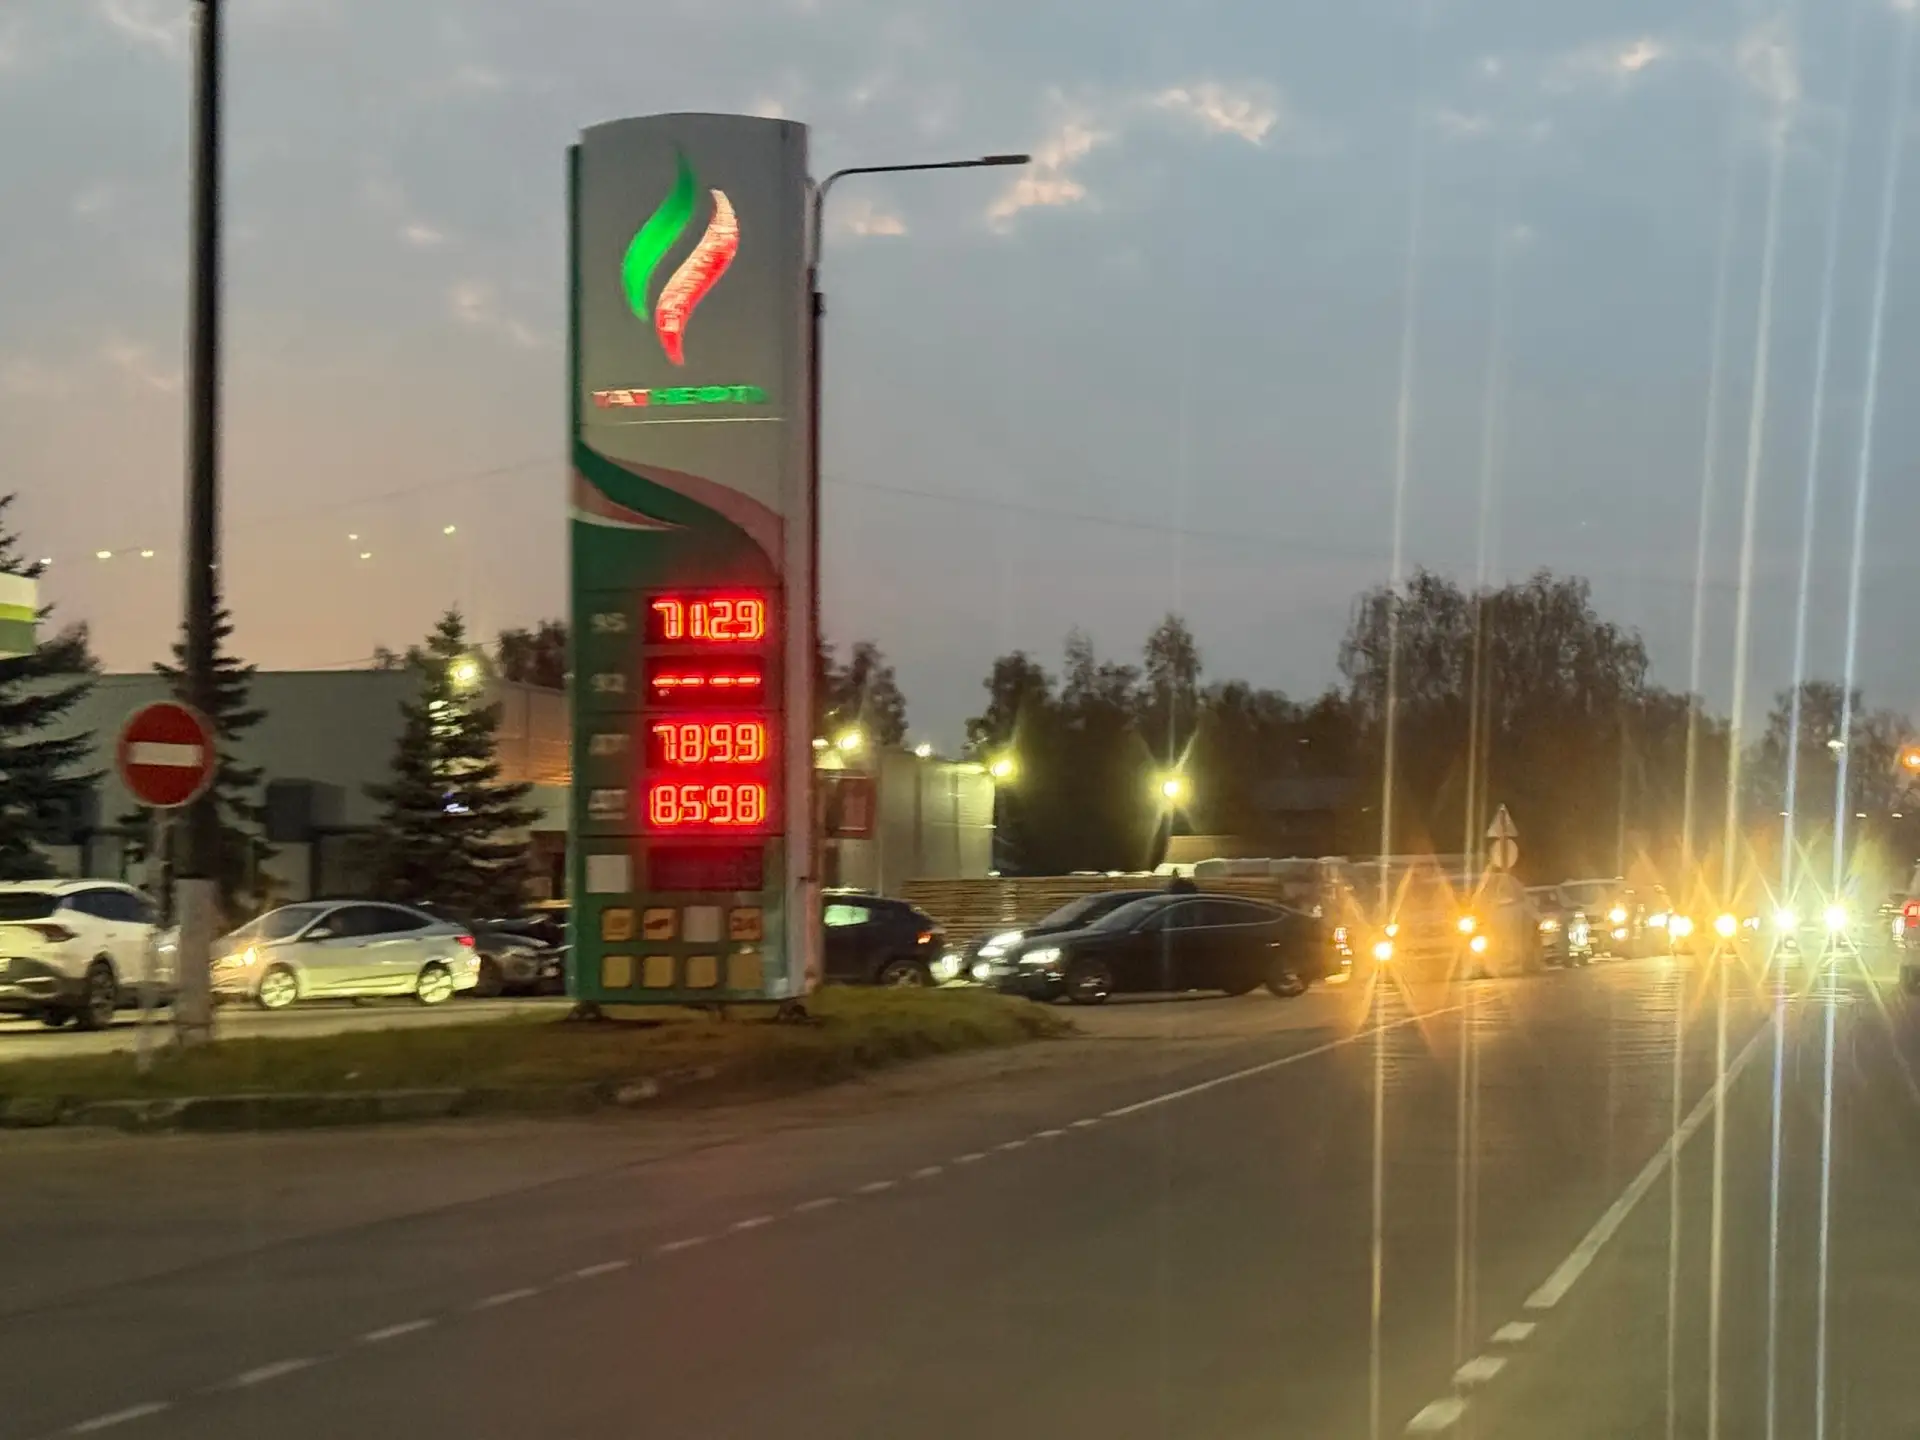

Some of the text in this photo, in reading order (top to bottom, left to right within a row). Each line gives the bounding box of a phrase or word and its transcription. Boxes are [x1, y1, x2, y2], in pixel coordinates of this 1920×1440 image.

[652, 600, 765, 640] 7129
[652, 722, 765, 763] 7899
[650, 784, 765, 824] 8598
